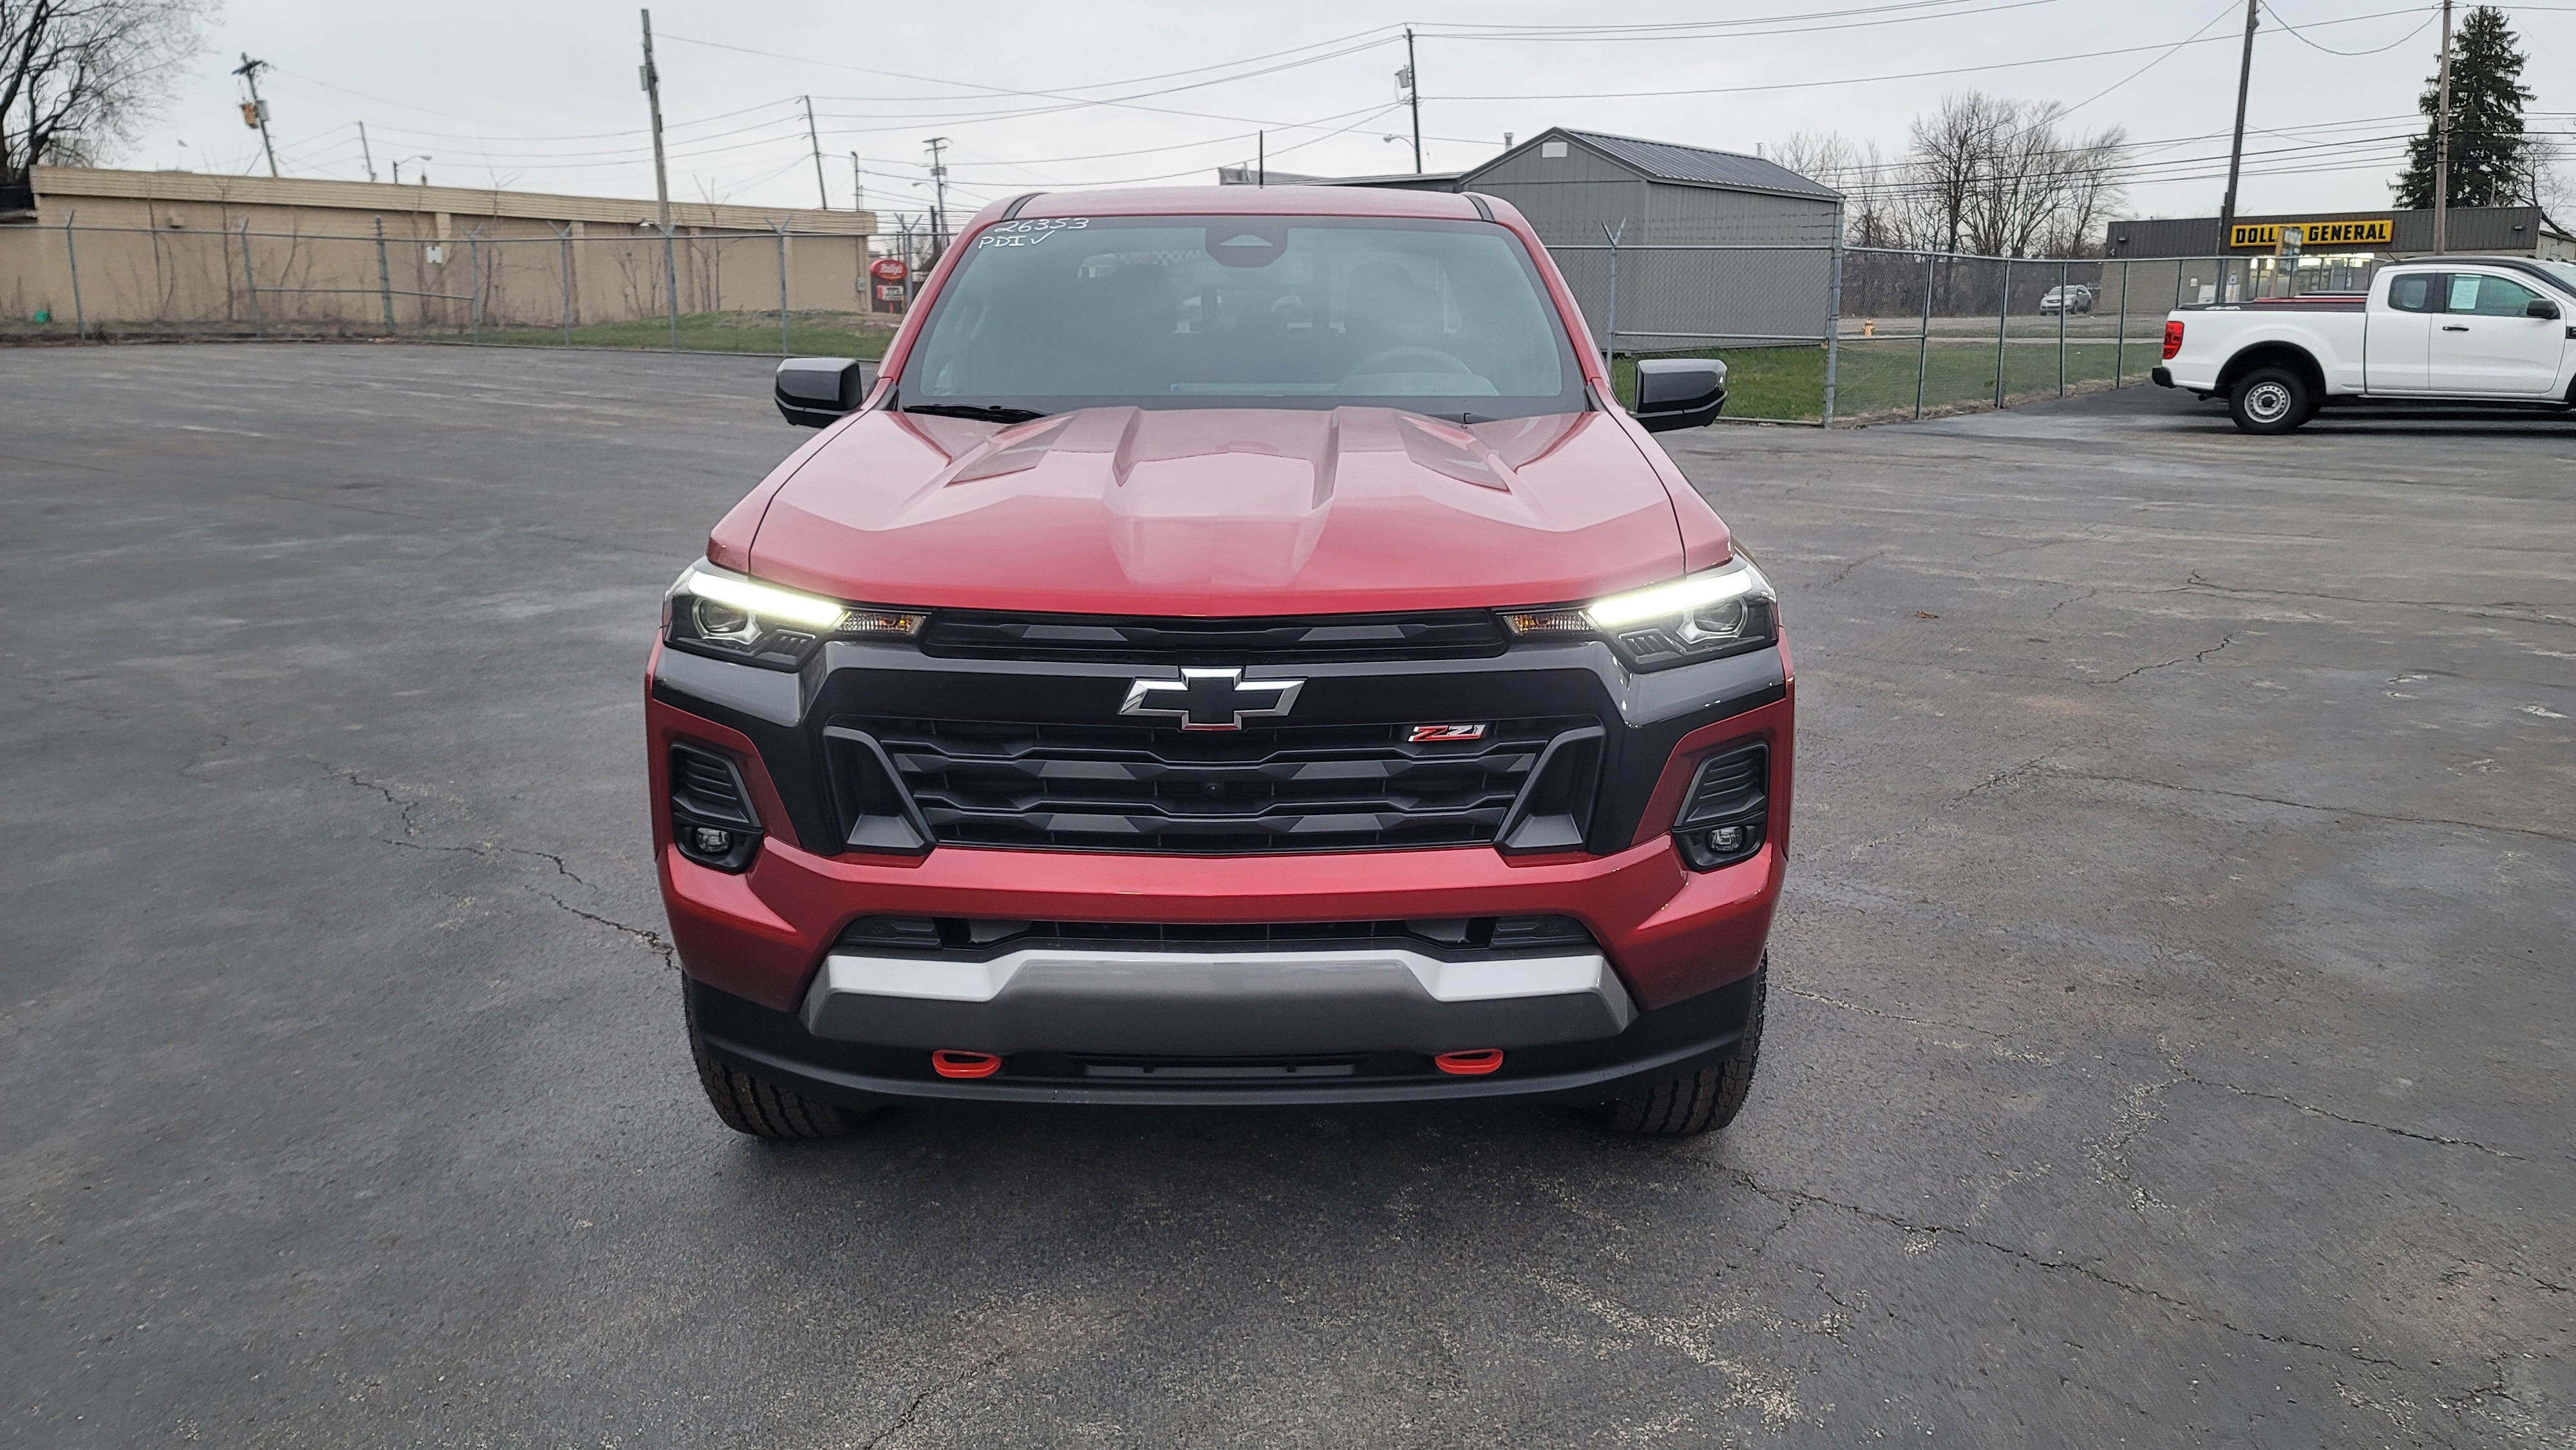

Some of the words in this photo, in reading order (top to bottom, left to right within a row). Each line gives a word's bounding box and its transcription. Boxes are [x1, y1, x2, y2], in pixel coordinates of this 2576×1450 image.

[994, 218, 1089, 232] 26353
[2235, 226, 2301, 243] DOLL
[2309, 224, 2386, 241] GENERAL
